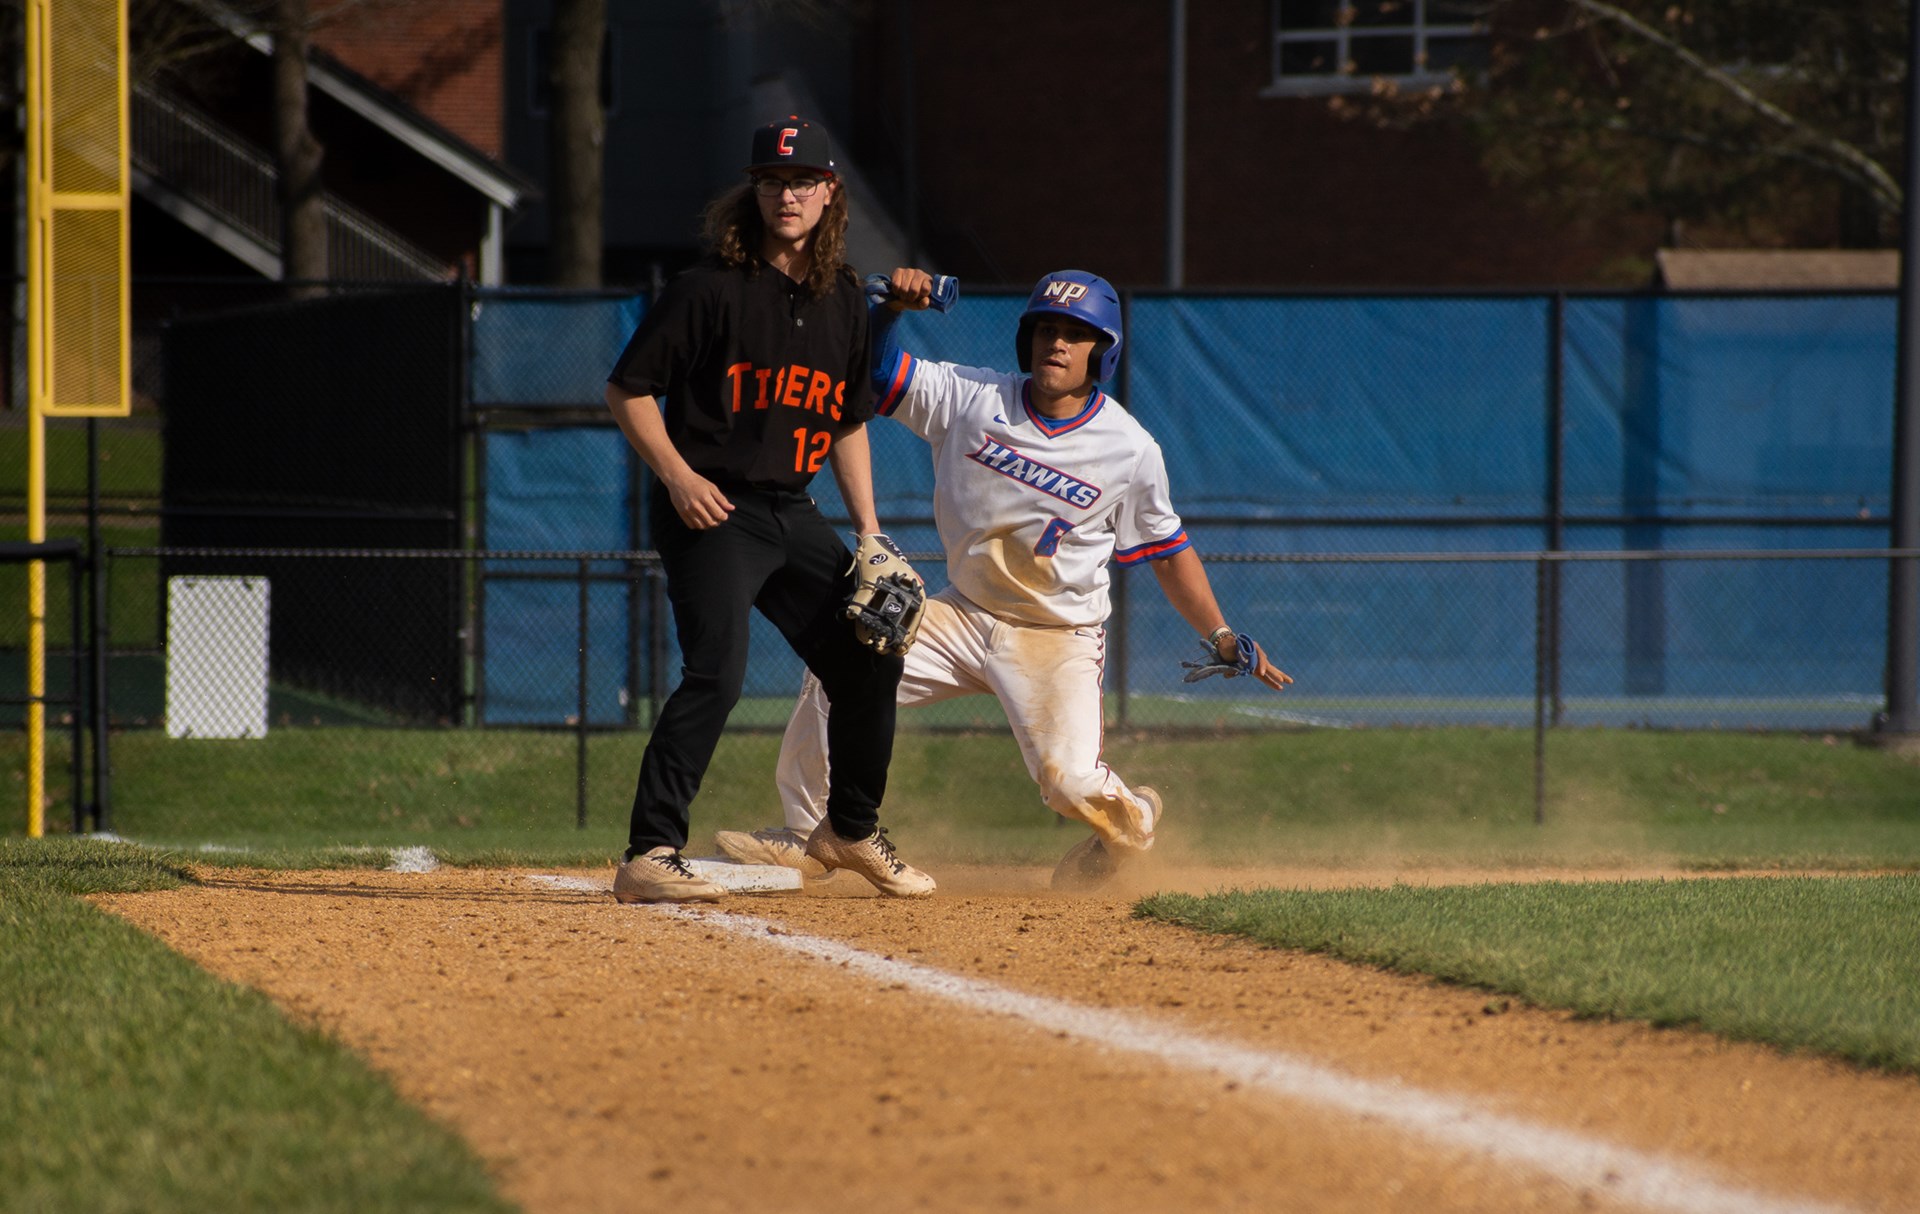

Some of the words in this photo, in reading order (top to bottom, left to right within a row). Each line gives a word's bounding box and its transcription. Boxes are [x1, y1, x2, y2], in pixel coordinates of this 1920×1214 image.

[777, 128, 798, 156] C
[1043, 281, 1088, 307] NP
[793, 427, 832, 473] 12
[975, 440, 1100, 508] HAWKS
